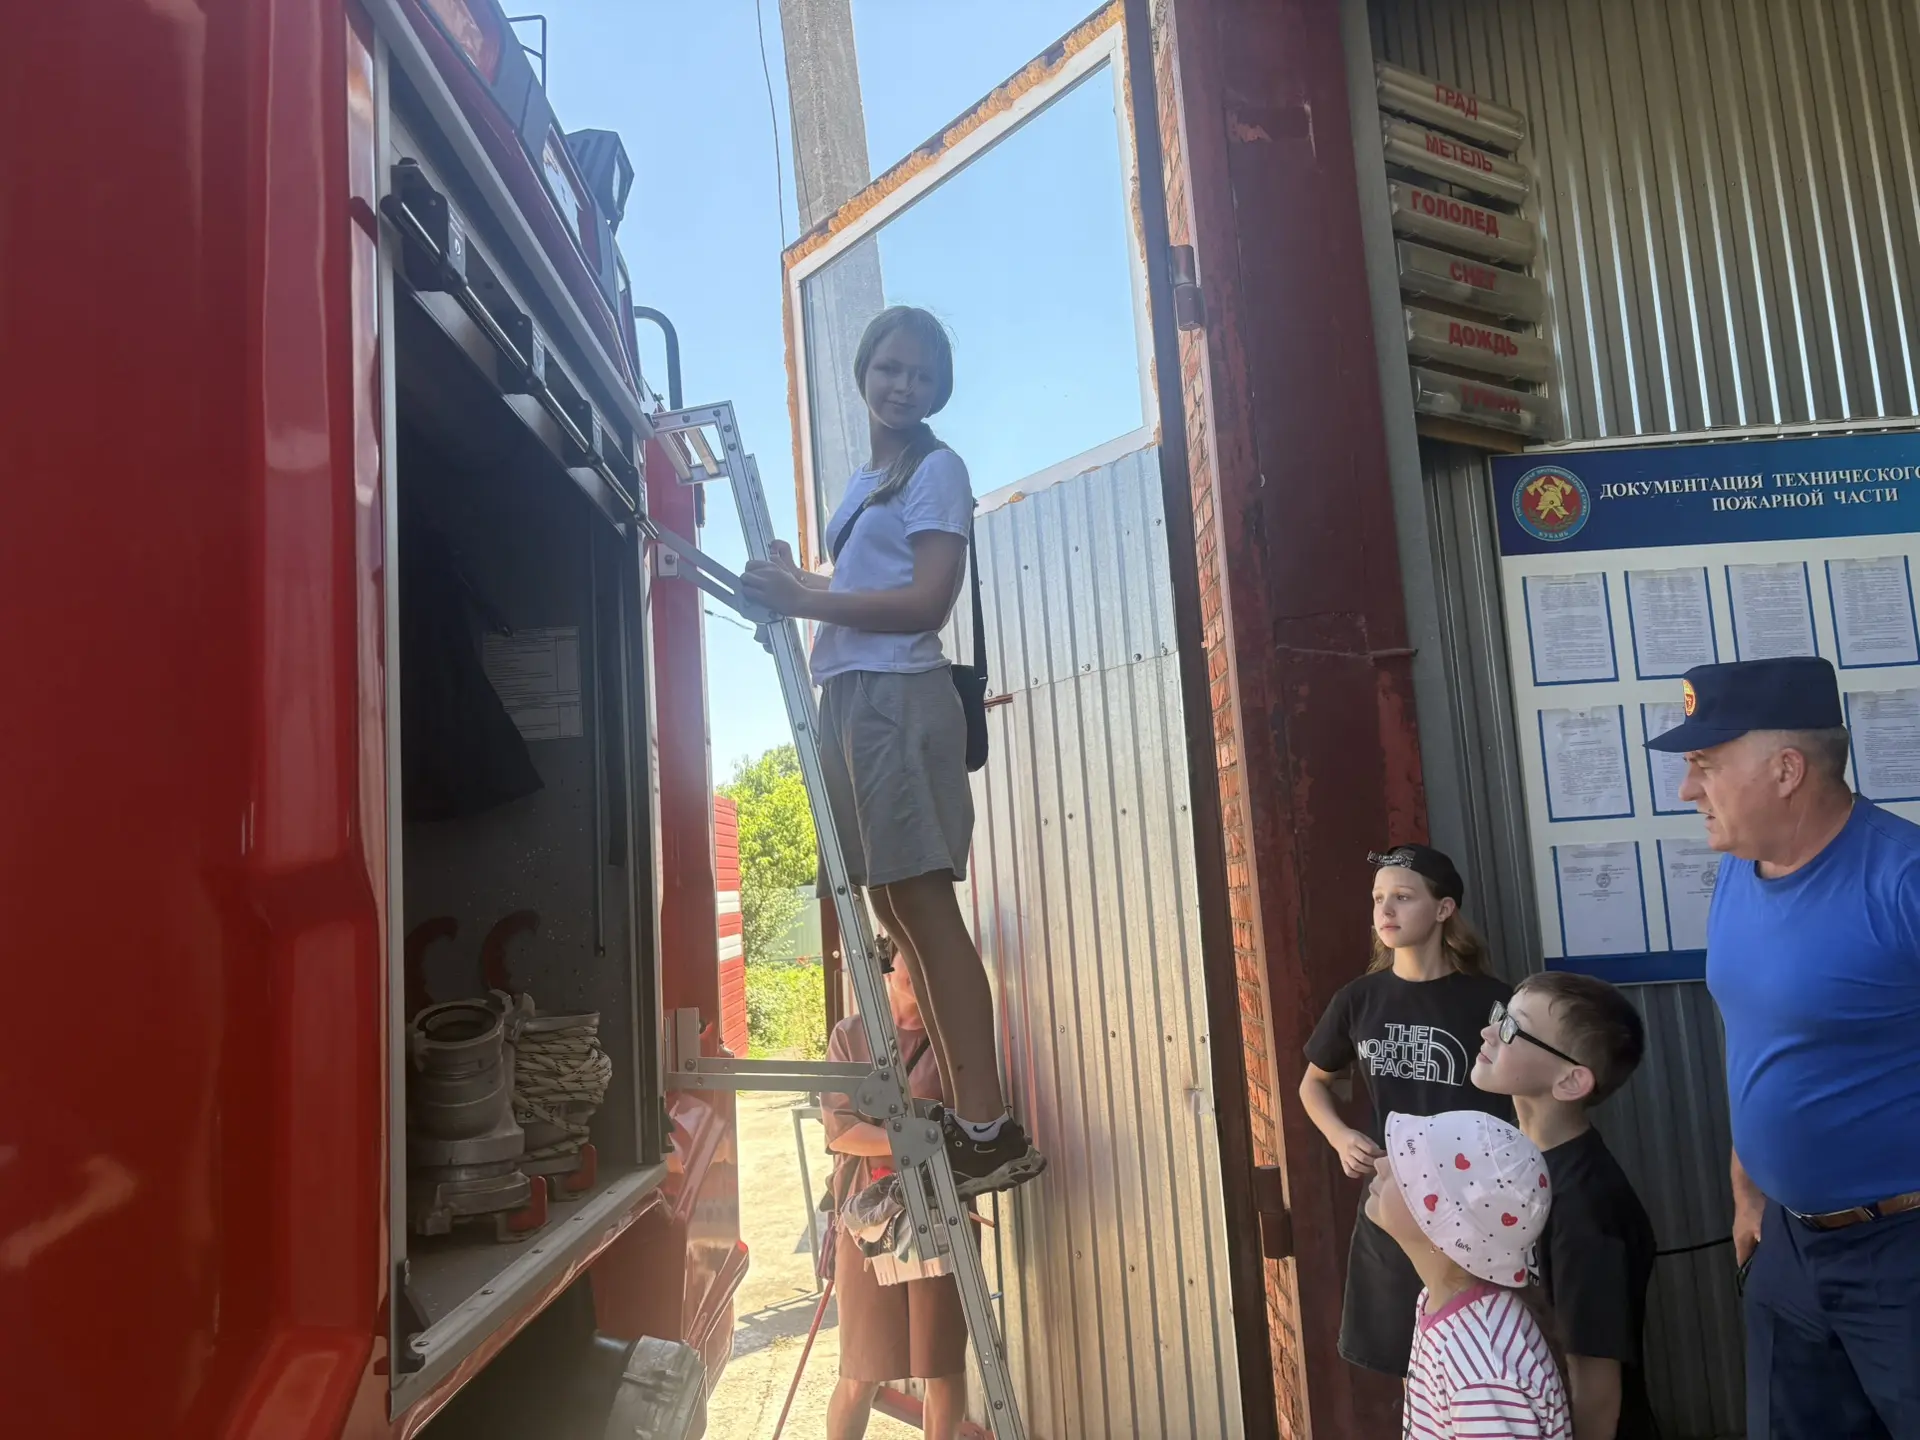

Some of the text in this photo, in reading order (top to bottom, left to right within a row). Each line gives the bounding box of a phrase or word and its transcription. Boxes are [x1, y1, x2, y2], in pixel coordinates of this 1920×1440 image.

[1435, 84, 1479, 120] ГРАД
[1425, 132, 1493, 173] МЕТЕЛЬ
[1411, 190, 1500, 239] ГОЛОЛЕД
[1449, 321, 1519, 357] ДОЖДЬ
[1600, 472, 1764, 501] ДОКУМЕНТАЦИЯ
[1712, 487, 1899, 512] ПОЖАРНОЙ ЧАСТИ
[1384, 1023, 1430, 1044] THE
[1357, 1038, 1429, 1062] NORTH
[1370, 1056, 1427, 1081] FACE
[1406, 1138, 1416, 1156] love
[1454, 1238, 1472, 1253] love
